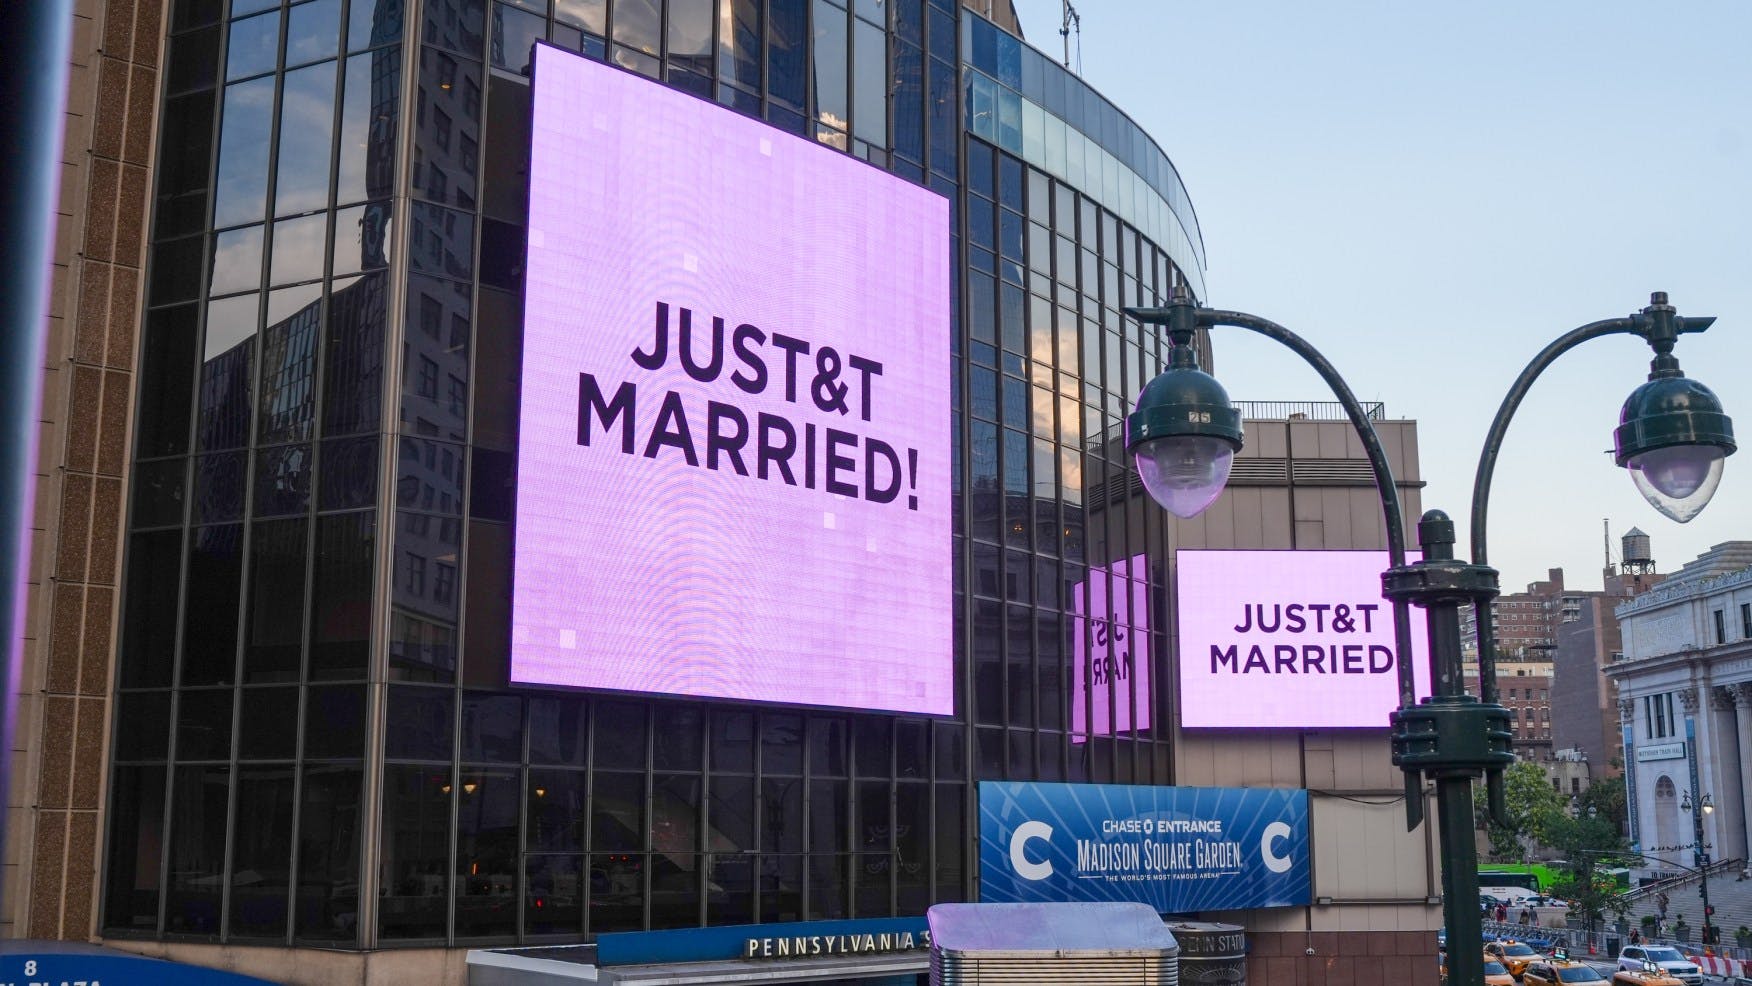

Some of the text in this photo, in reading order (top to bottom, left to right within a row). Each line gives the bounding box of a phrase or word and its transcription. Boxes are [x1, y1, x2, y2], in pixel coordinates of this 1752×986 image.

[630, 301, 883, 422] JUST&T
[577, 372, 918, 511] MARRIED!
[1234, 603, 1379, 634] JUST&T
[1102, 820, 1222, 833] CHASE ENTRANCE
[1009, 820, 1054, 880] C
[1077, 839, 1140, 872] MADISON
[1144, 838, 1192, 873] SQUARE
[1260, 821, 1293, 874] C
[1153, 873, 1171, 881] MOST
[1173, 872, 1197, 880] FAMOUS
[749, 932, 915, 957] PENNSYLVANIA
[24, 960, 37, 977] 8
